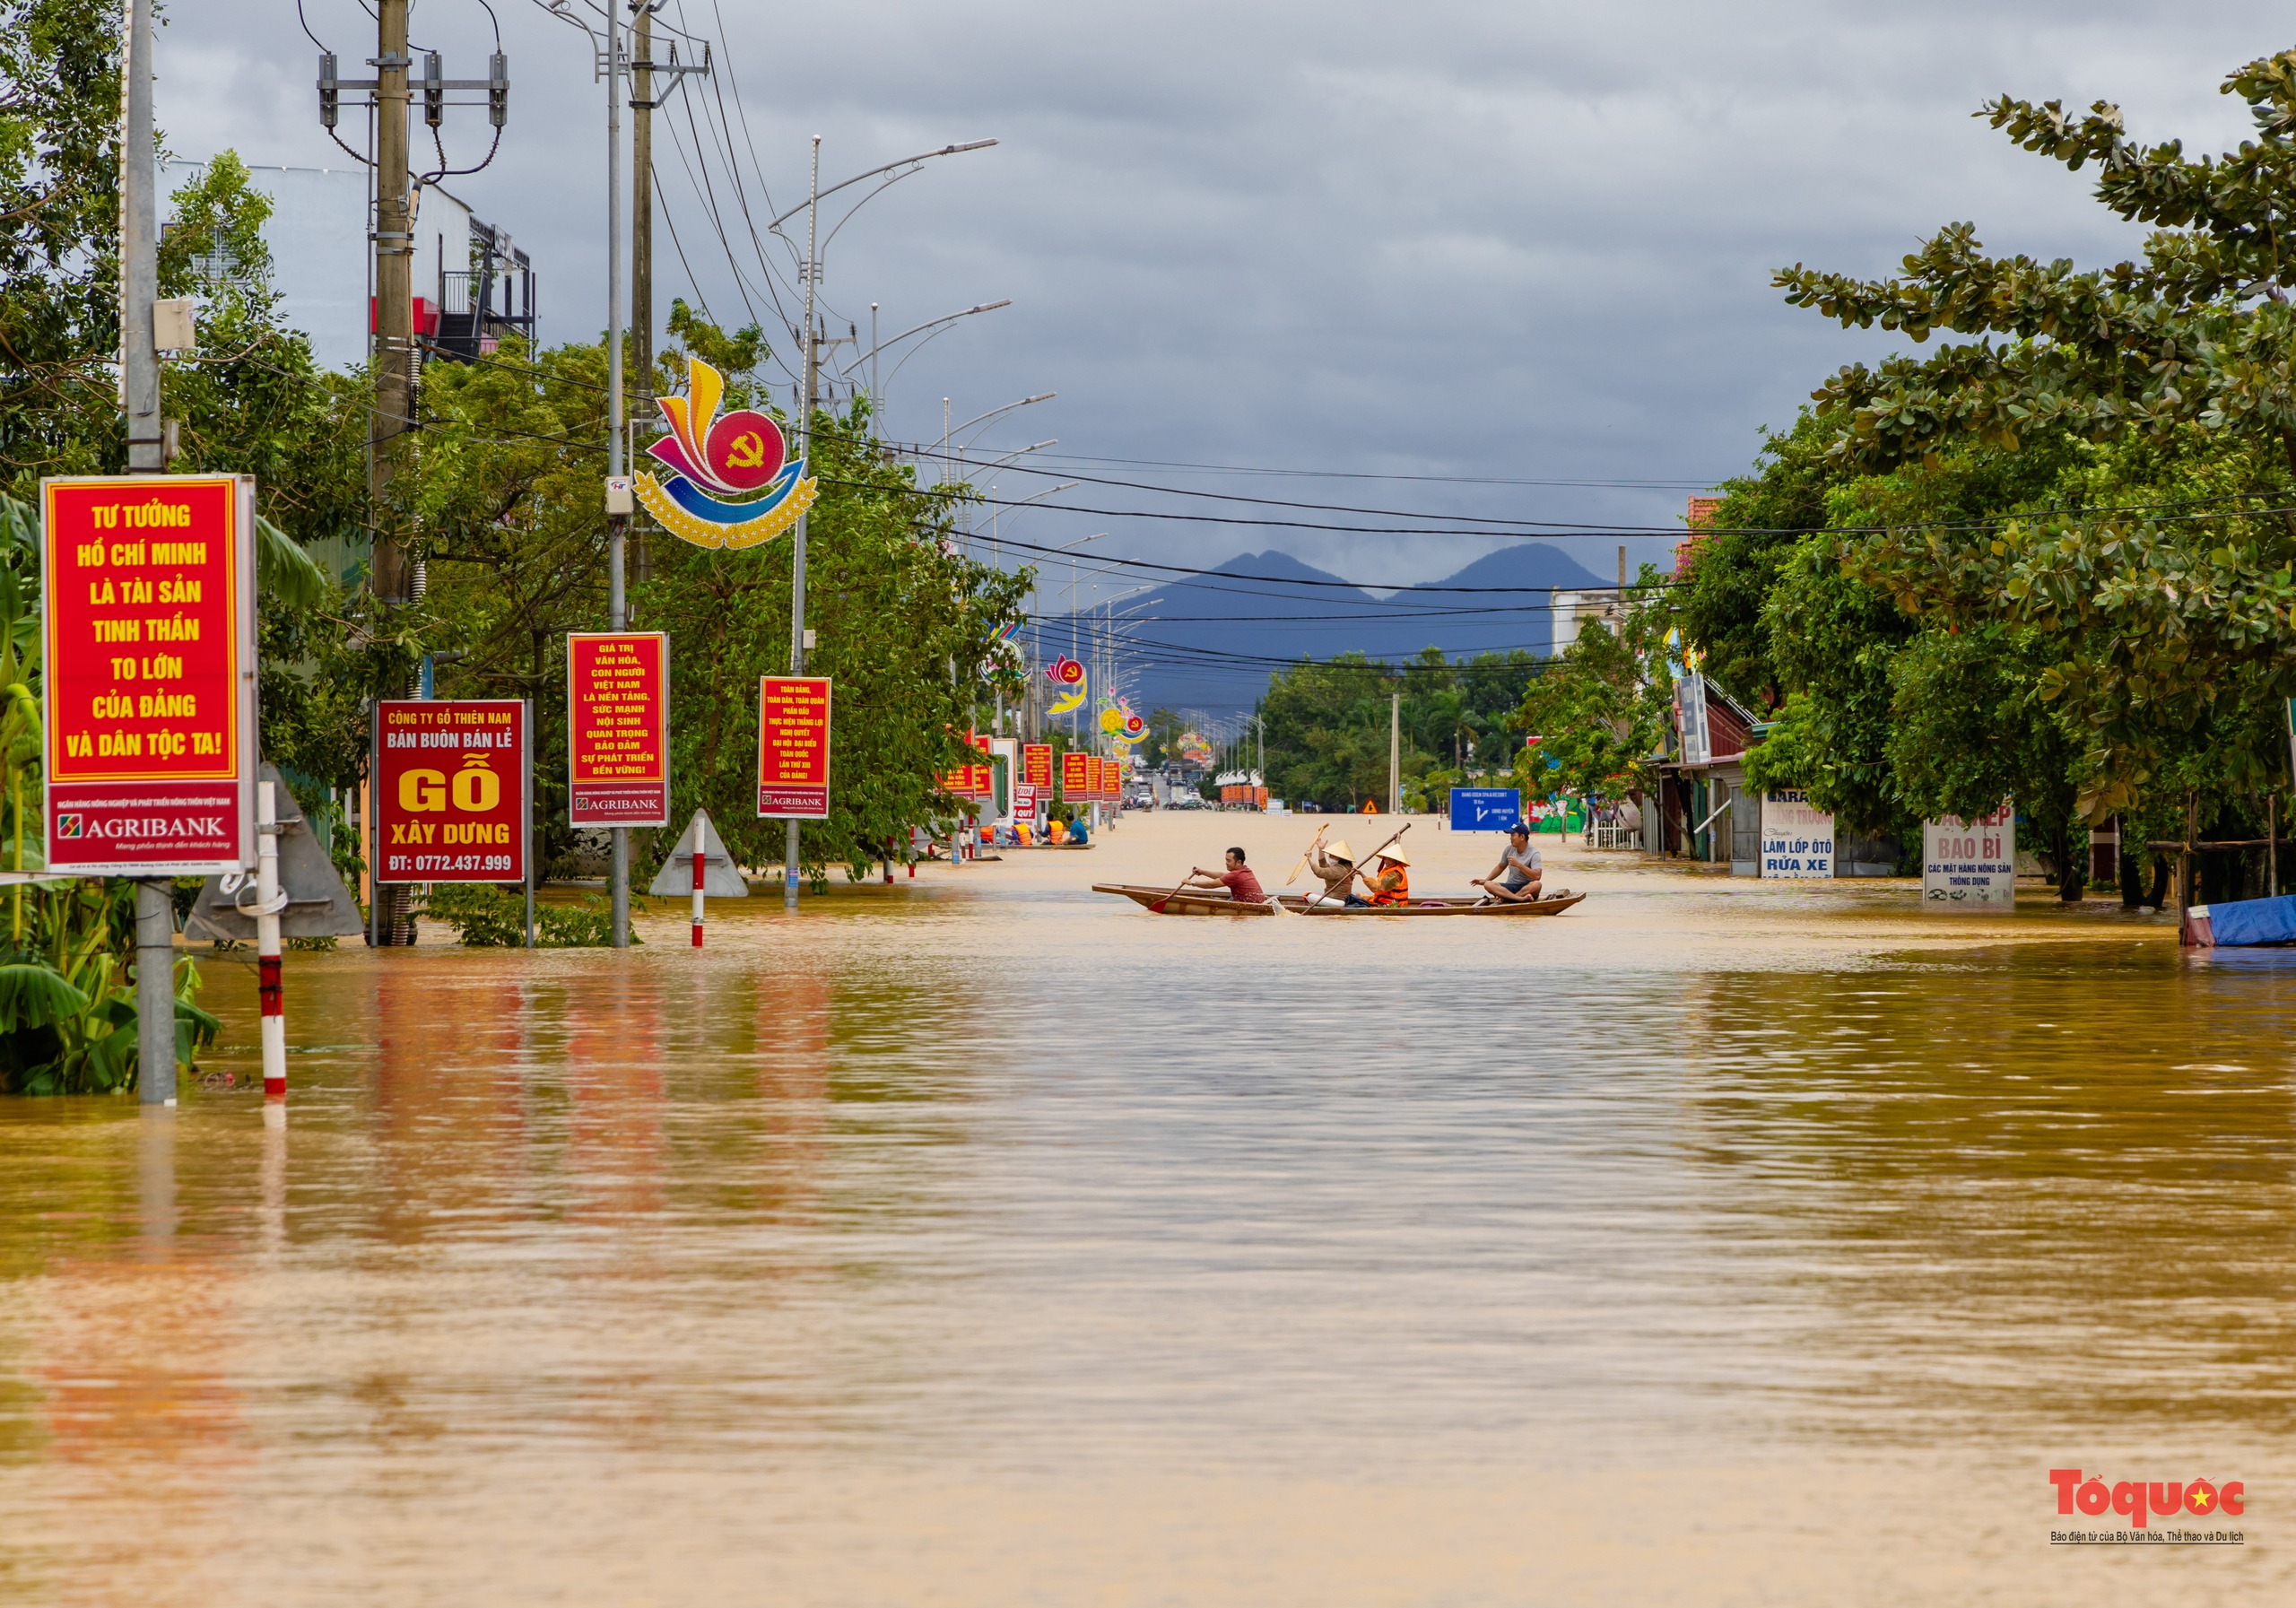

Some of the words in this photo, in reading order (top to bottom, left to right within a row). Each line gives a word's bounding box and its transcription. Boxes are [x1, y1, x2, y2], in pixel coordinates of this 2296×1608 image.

[91, 504, 119, 528] TƯ
[123, 498, 190, 527] TƯỞNG
[77, 536, 105, 567] HỒ
[110, 539, 145, 566] CHÍ
[152, 543, 206, 565] MINH
[90, 578, 115, 604] LÀ
[120, 577, 152, 604] TÀI
[159, 573, 201, 603] SẢN
[92, 620, 140, 642] TINH
[145, 612, 200, 641] THẦN
[598, 643, 615, 653] GIÁ
[618, 644, 634, 654] TRỊ
[110, 657, 136, 680] TO
[142, 652, 182, 679] LỚN
[595, 656, 615, 665] VĂN
[591, 669, 612, 677] CON
[614, 666, 645, 676] NGƯỜI
[593, 680, 614, 691] VIỆT
[617, 681, 640, 689] NAM
[92, 689, 134, 719] CỦA
[139, 688, 196, 717] ĐẢNG
[583, 692, 596, 701] LÀ
[388, 710, 417, 725] CÔNG
[420, 713, 433, 724] TY
[437, 708, 450, 724] GỖ
[454, 710, 484, 724] THIÊN
[488, 713, 511, 724] NAM
[592, 704, 612, 714] SỨC
[614, 705, 645, 715] MẠNH
[596, 717, 614, 727] NỘI
[617, 717, 640, 726] SINH
[387, 729, 416, 748] BÁN
[421, 729, 459, 748] BUÔN
[463, 729, 492, 748] BÁN
[496, 726, 512, 748] LẺ
[587, 730, 613, 739] QUAN
[615, 729, 648, 739] TRỌNG
[66, 730, 93, 757] VÀ
[99, 729, 141, 756] DÂN
[147, 728, 186, 761] TỘC
[191, 733, 222, 754] TA!
[595, 740, 614, 751] BẢO
[617, 739, 640, 750] ĐẢM
[581, 753, 596, 764] SỰ
[597, 752, 622, 762] PHÁT
[625, 751, 654, 761] TRIỂN
[615, 765, 646, 774] VỮNG!
[399, 752, 500, 813] GỖ
[589, 799, 658, 810] AGRIBANK
[771, 797, 822, 806] AGRIBANK
[84, 816, 226, 839] AGRIBANK
[391, 819, 436, 844] XÂY
[1763, 839, 1786, 853] LÀM
[1789, 837, 1809, 854] LỐP
[1812, 839, 1832, 854] ÔTÔ
[1938, 838, 1976, 859] BAO
[1982, 833, 2001, 859] BÌ
[389, 855, 412, 870] ĐT:
[415, 855, 511, 871] 0772.437.999
[1767, 855, 1801, 871] RỬA
[1806, 859, 1828, 871] XE
[1928, 863, 1942, 873] CÁC
[1943, 862, 1957, 875] MẶT
[1959, 863, 1976, 873] HÀNG
[1978, 863, 1996, 873] NÔNG
[1997, 862, 2012, 873] SẢN
[1949, 875, 1970, 886] THÔNG
[1972, 877, 1990, 887] DỤNG
